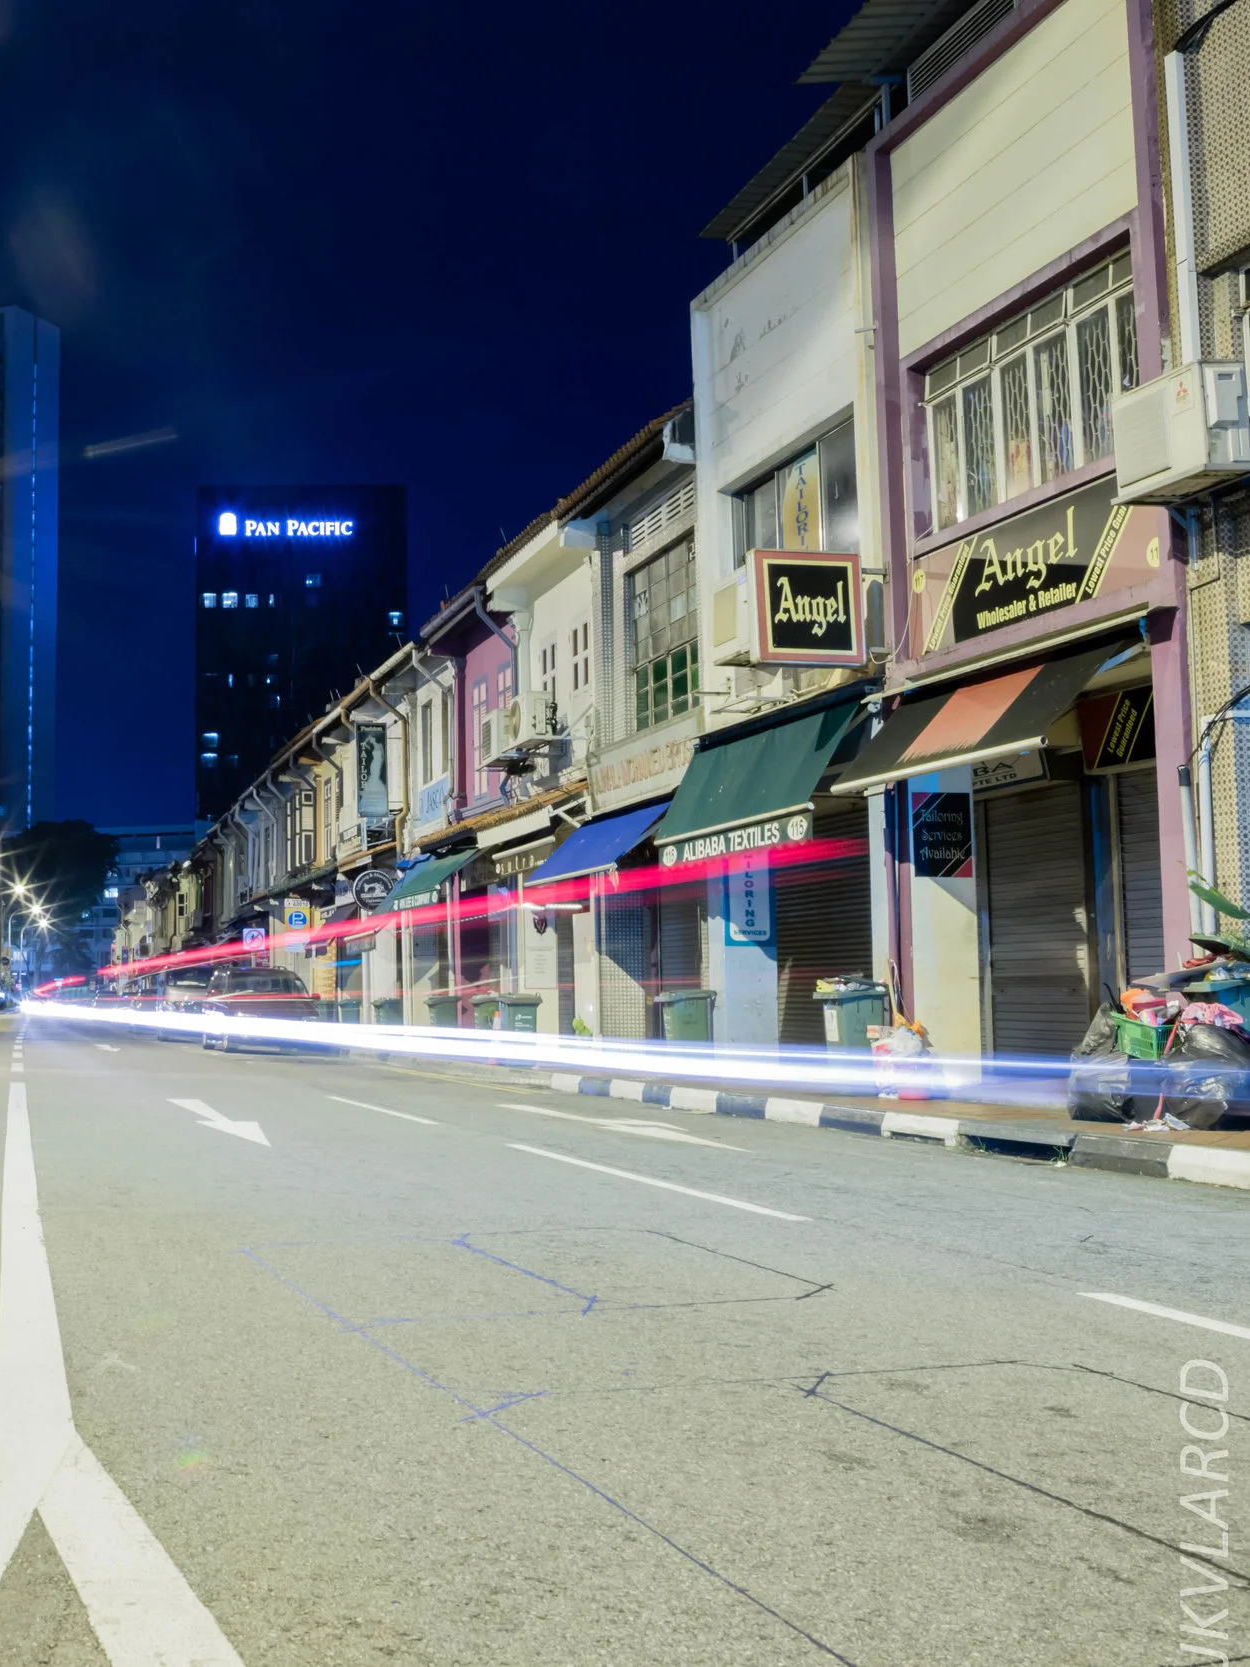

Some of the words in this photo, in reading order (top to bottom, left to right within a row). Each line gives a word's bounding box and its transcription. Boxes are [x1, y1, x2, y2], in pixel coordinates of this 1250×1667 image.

[245, 520, 279, 536] PAN
[287, 520, 353, 536] PACIFIC
[795, 463, 810, 550] TAILORI
[975, 505, 1079, 597] Angel
[1085, 557, 1105, 594] Lowest
[1099, 529, 1116, 557] Price
[774, 576, 847, 636] Angel
[976, 599, 1027, 630] Wholesaler
[1028, 594, 1037, 611] &
[1039, 582, 1078, 608] Retailer
[1107, 722, 1122, 754] Lowest
[1118, 699, 1130, 723] Price
[1116, 708, 1138, 757] Guaranteed
[995, 773, 1017, 782] LTD
[920, 809, 963, 825] Tailoring
[921, 829, 963, 841] Services
[682, 835, 726, 862] ALIBABA
[728, 823, 780, 852] TEXTILES
[919, 847, 966, 861] Available
[744, 855, 755, 927] ILORING
